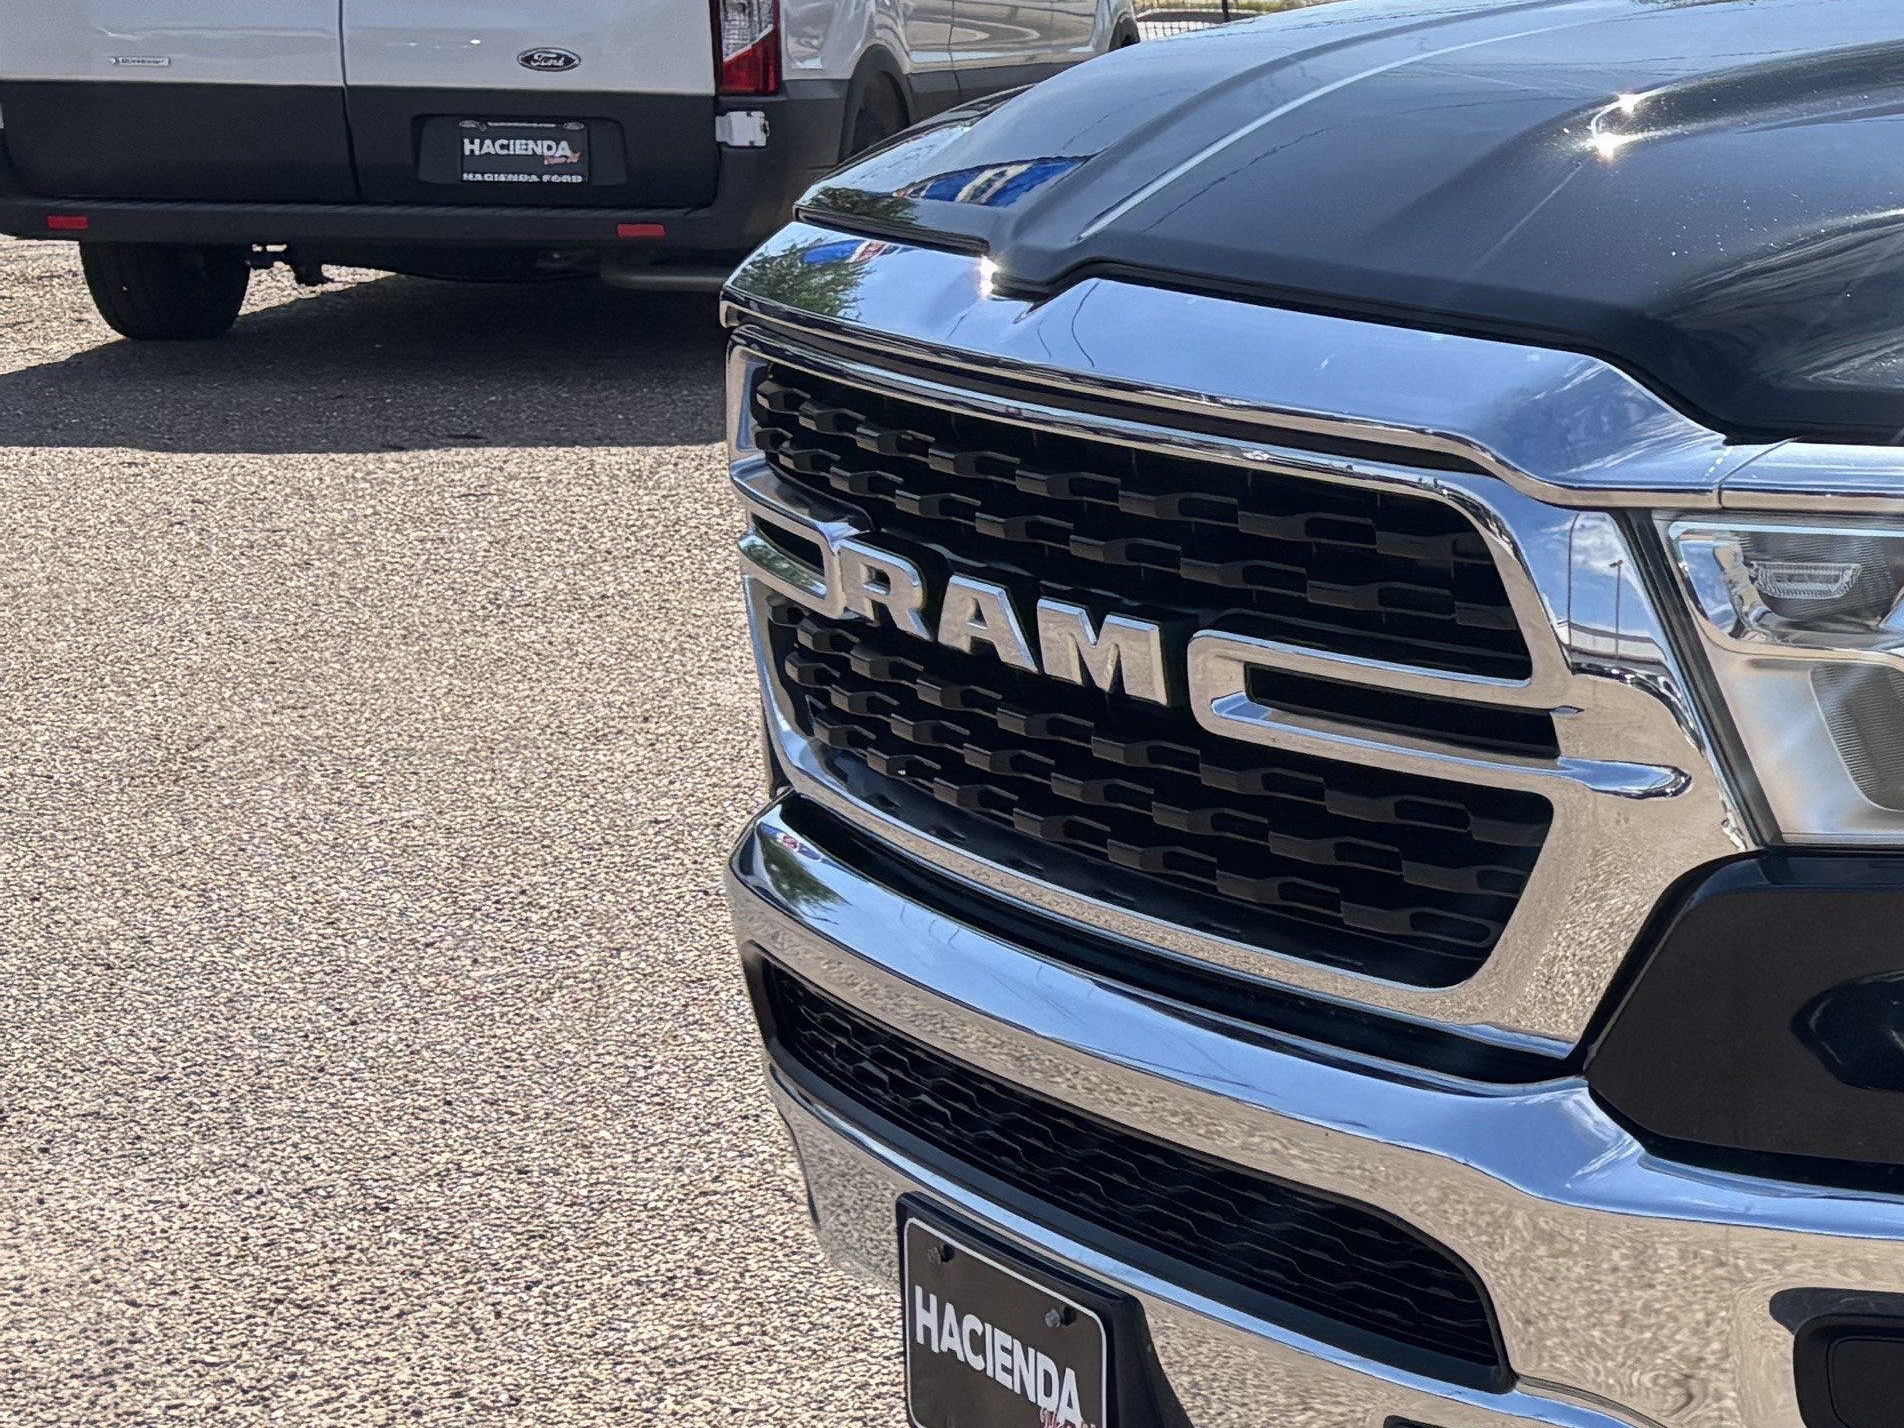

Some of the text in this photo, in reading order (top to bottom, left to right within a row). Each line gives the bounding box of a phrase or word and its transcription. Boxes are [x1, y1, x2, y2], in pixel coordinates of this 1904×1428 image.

[462, 138, 572, 157] HACIENDA
[838, 544, 1170, 706] RAM
[914, 1284, 1083, 1428] HACIENDA
